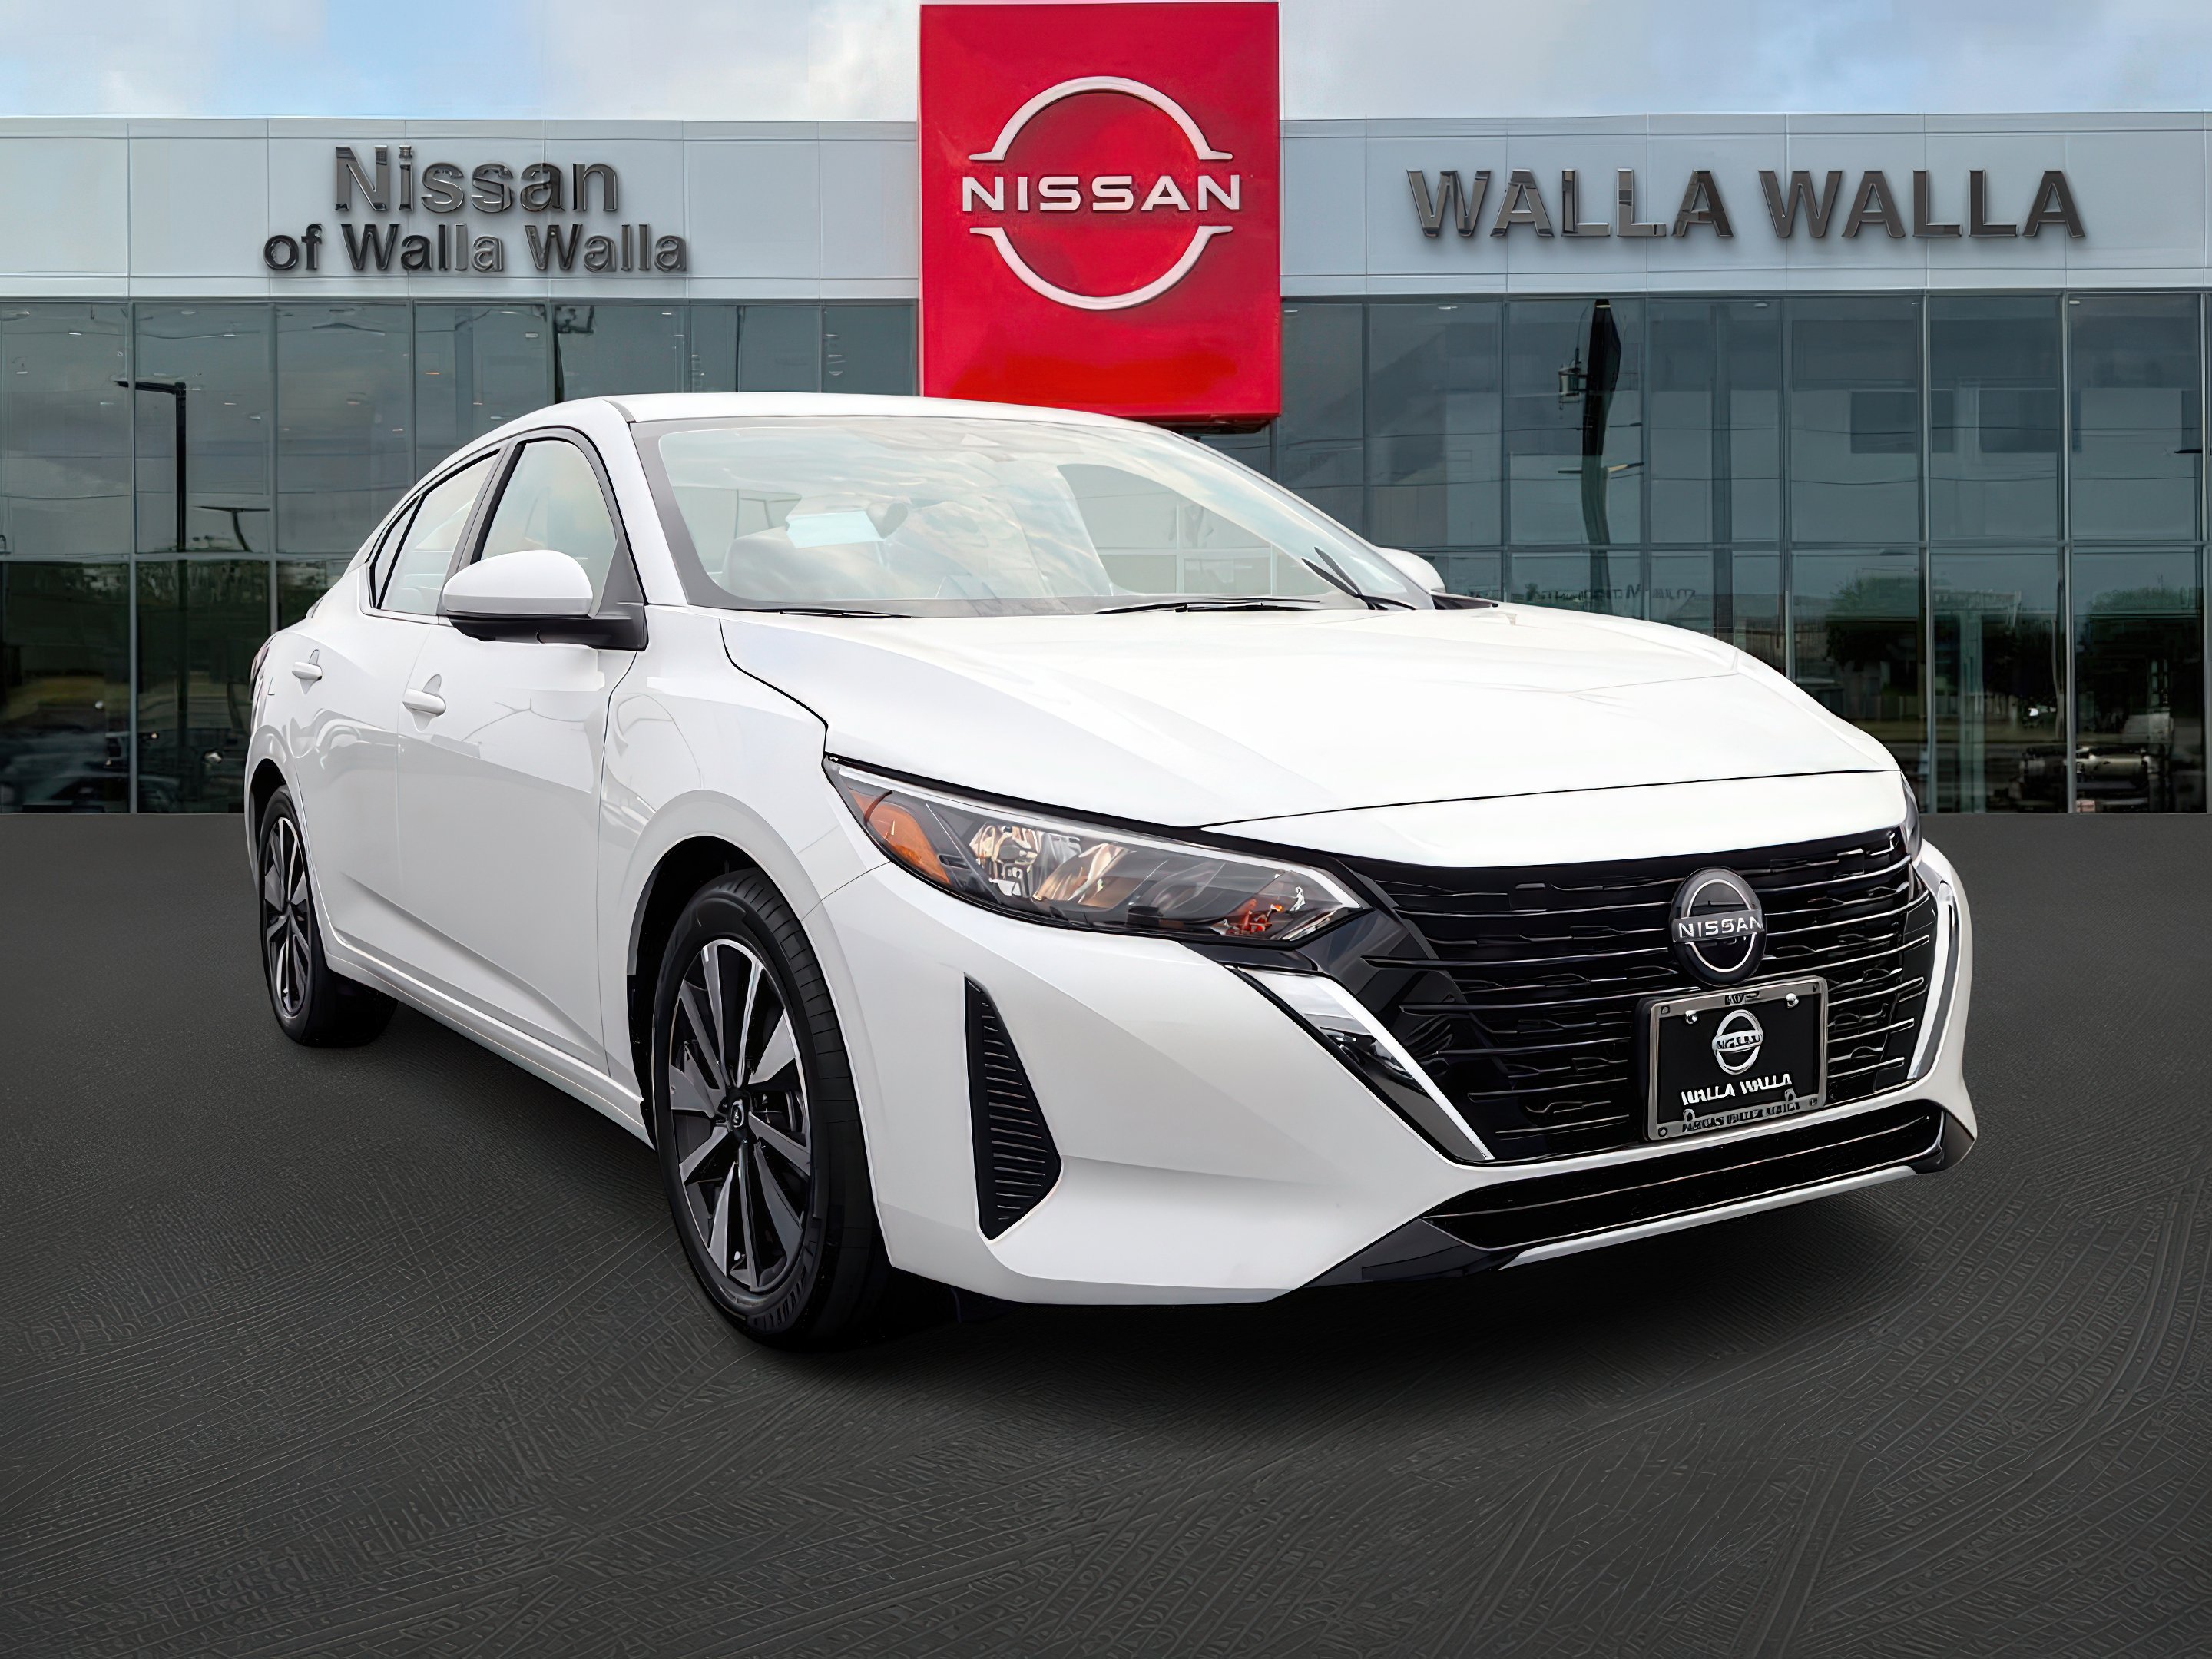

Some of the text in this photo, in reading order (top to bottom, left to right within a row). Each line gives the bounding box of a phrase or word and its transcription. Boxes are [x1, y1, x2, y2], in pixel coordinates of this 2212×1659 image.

[335, 144, 617, 213] Nissan
[962, 174, 1240, 211] NISSAN
[1406, 169, 2085, 237] WALLA WALLA
[263, 224, 687, 272] of Walla Walla
[1679, 916, 1763, 938] NISSAN
